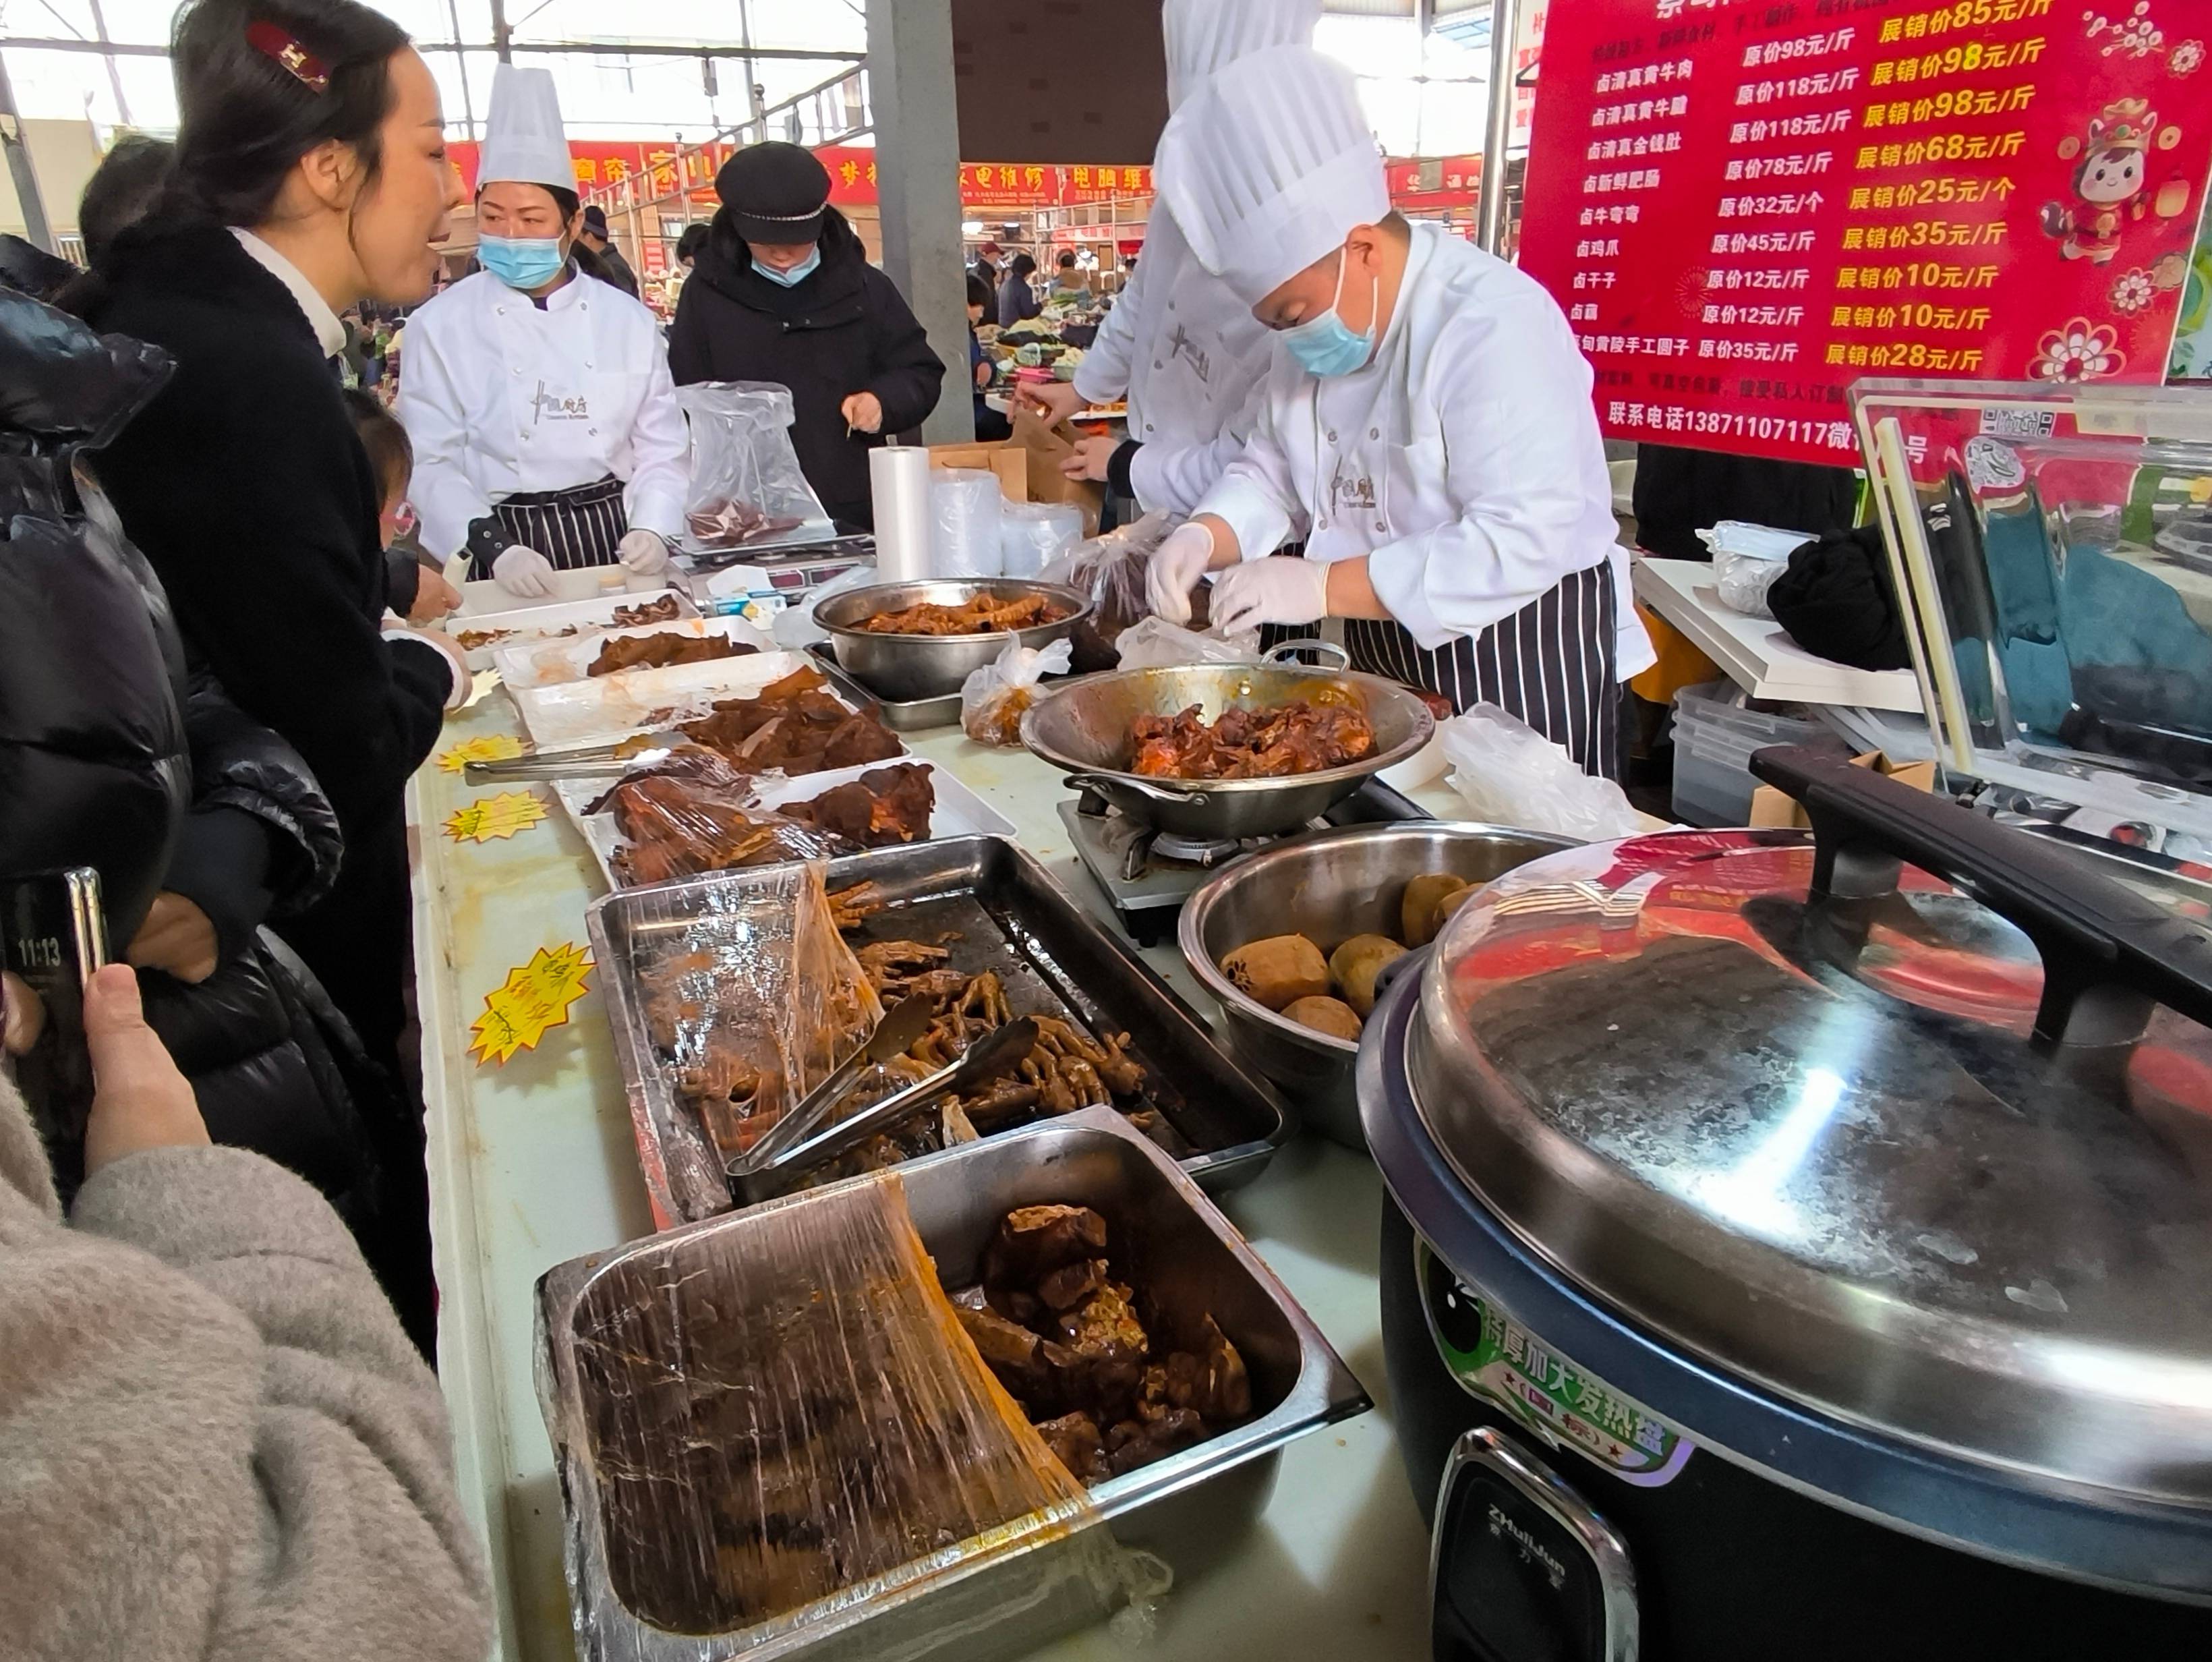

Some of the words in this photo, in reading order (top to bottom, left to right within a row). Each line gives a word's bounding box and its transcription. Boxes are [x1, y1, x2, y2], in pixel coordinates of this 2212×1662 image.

[1596, 58, 1693, 93] 卤清真黄牛肉
[1742, 27, 1855, 67] 原价98元/斤
[1735, 67, 1860, 106] 原价118元/斤
[1870, 36, 2047, 86] 展销价98元/斤
[1729, 109, 1852, 144] 原价118元/斤
[1863, 84, 2037, 127] 展销价98元/斤
[1724, 151, 1833, 181] 原价78元/斤
[1855, 130, 2026, 169] 展销价68元/斤
[1073, 167, 1157, 190] 电脑维
[1718, 191, 1824, 217] 原价32元/个
[1849, 176, 2016, 209] 展销价25元/个
[1576, 239, 1619, 258] 卤鸡爪
[1710, 230, 1816, 254] 原价45元/斤
[1842, 221, 2008, 250] 展销价35元/斤
[1573, 272, 1617, 289] 卤干子
[1706, 268, 1810, 289] 原价12元/斤
[1836, 263, 2000, 289] 展销价10元/斤
[1701, 305, 1805, 326] 原价12元/斤
[1830, 304, 1991, 331] 展销价10元/斤
[1697, 339, 1799, 362] 原价35元/斤
[1825, 343, 1983, 372] 展销价28元/斤
[18, 937, 61, 967] 11:13
